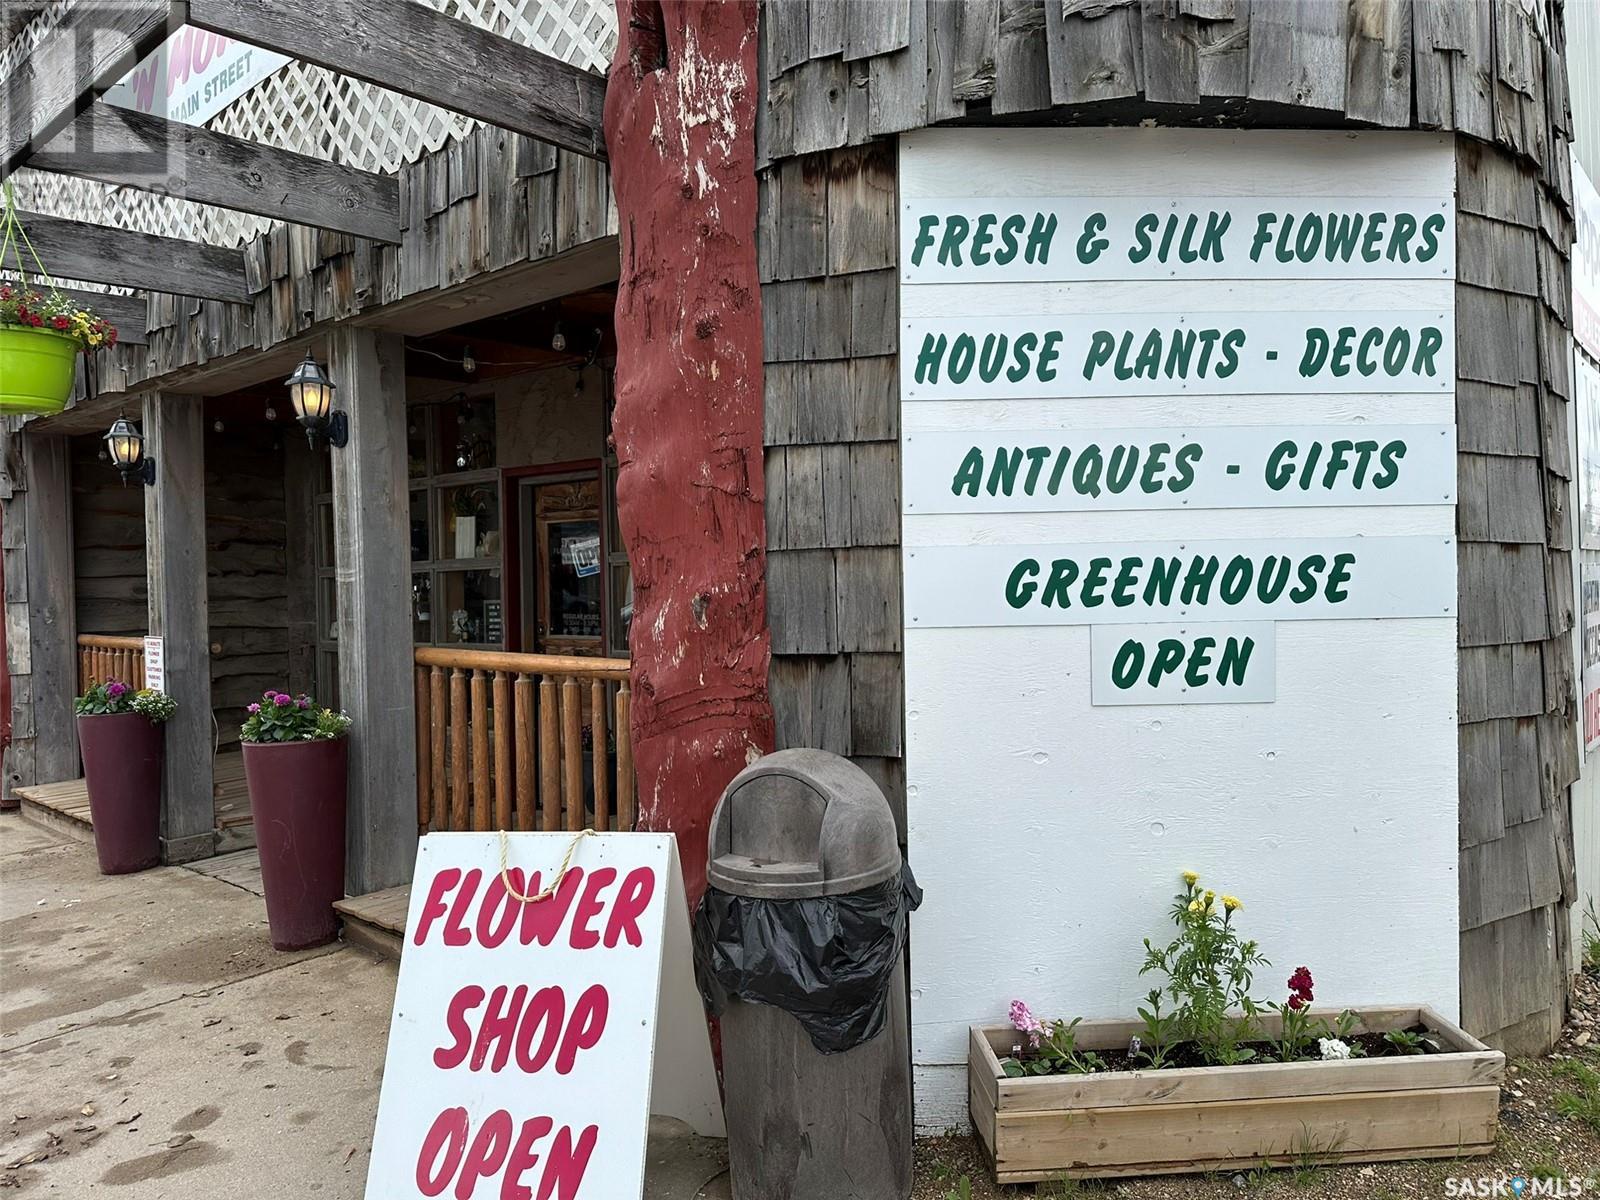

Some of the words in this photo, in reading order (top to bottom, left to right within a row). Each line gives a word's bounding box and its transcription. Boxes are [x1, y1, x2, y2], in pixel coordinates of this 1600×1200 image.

[170, 91, 200, 121] MAIN
[204, 49, 253, 103] STREET
[911, 212, 1058, 268] FRESH
[1076, 213, 1110, 265] &
[1128, 211, 1232, 264] SILK
[1249, 212, 1446, 264] FLOWERS
[914, 331, 1063, 385] HOUSE
[1082, 328, 1246, 381] PLANTS
[1298, 326, 1443, 378] DECOR
[951, 443, 1203, 498] ANTIQUES
[1265, 440, 1407, 491] GIFTS
[1005, 553, 1356, 609] GREENHOUSE
[1111, 636, 1255, 690] OPEN
[413, 866, 656, 950] FLOWER
[433, 984, 609, 1075] SHOP
[416, 1107, 599, 1200] OPEN
